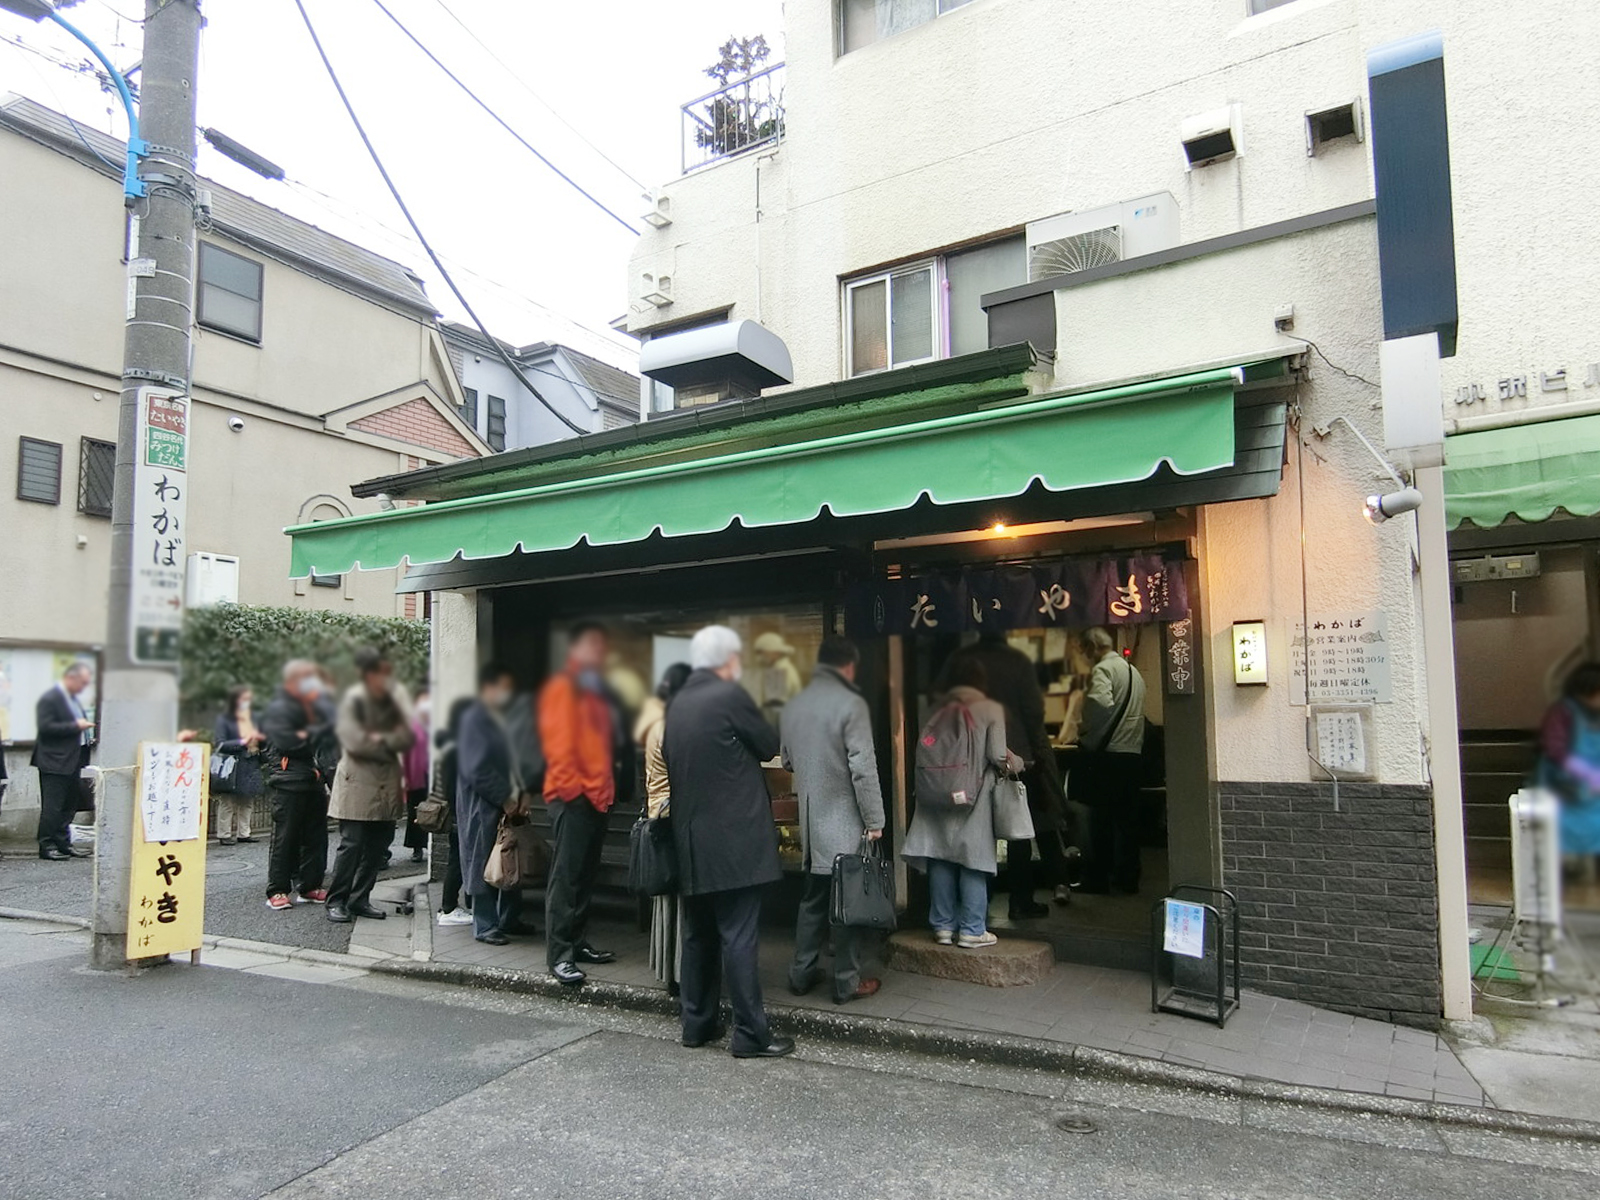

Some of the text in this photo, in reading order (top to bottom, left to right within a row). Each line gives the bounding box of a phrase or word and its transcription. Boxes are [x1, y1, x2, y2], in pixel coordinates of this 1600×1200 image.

[151, 474, 182, 566] わかば
[909, 573, 1142, 629] たいやき
[1313, 616, 1366, 630] わかば
[1239, 636, 1255, 672] わかば
[156, 841, 182, 924] やき
[137, 895, 155, 947] わかば
